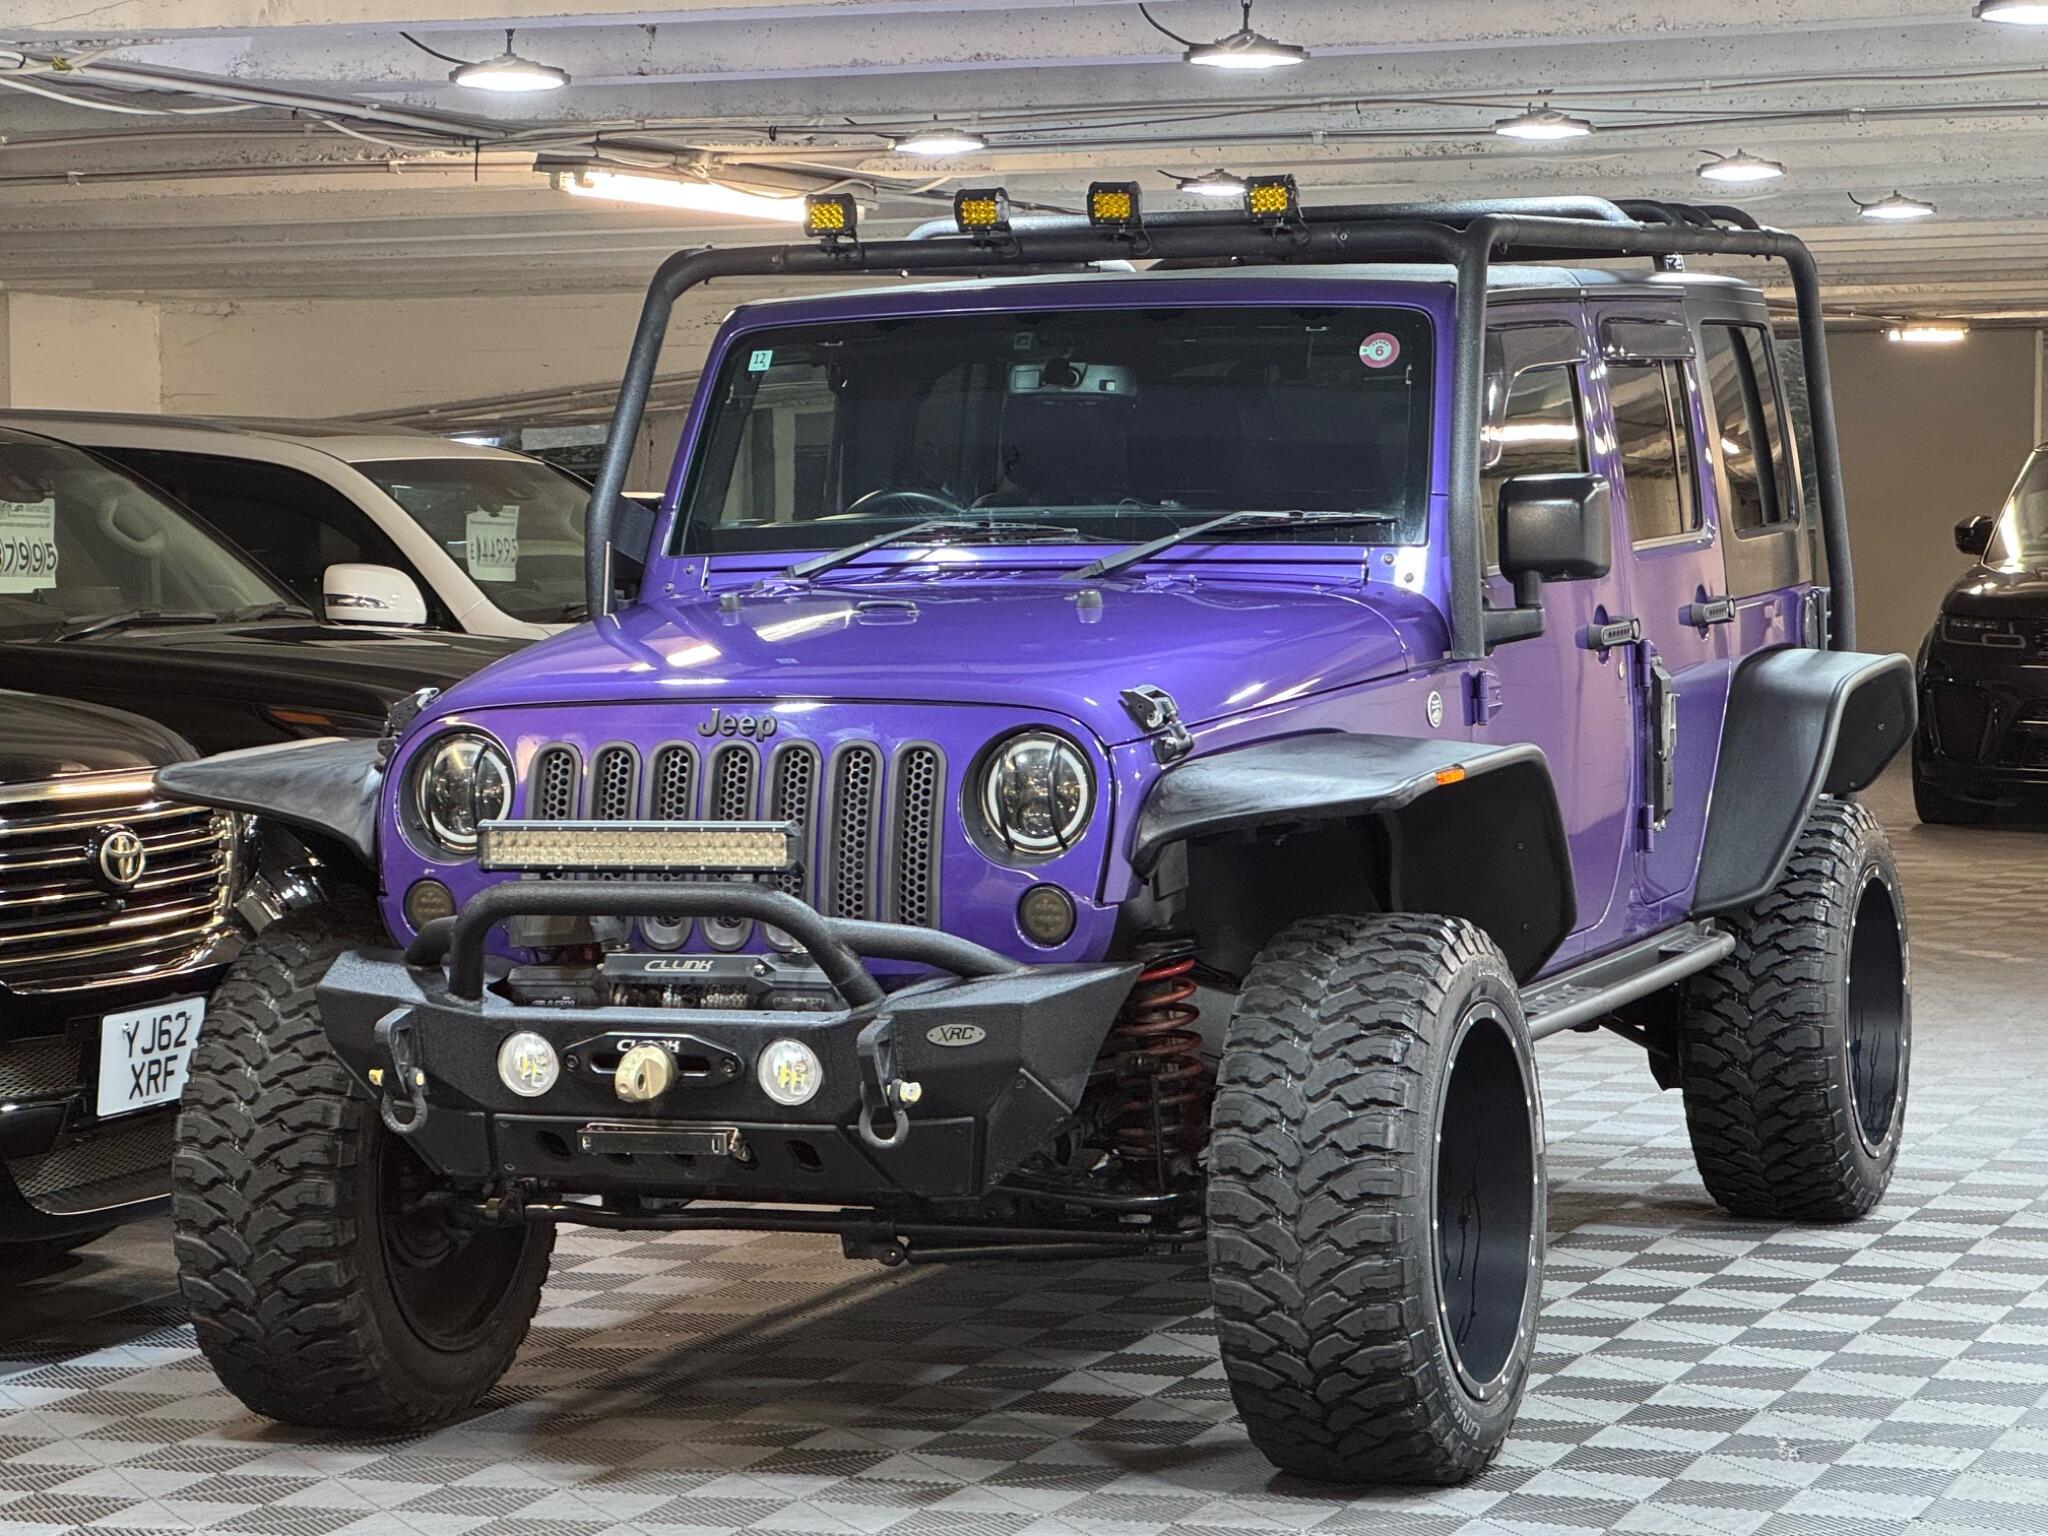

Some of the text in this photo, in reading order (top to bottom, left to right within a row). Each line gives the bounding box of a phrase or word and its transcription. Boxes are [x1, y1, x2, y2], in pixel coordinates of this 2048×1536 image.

[754, 352, 766, 364] 12
[1375, 346, 1384, 356] 6
[0, 542, 57, 572] 7995
[697, 707, 777, 742] Jeep
[125, 1011, 188, 1058] YJ62
[937, 1026, 975, 1042] XRC
[129, 1055, 178, 1100] XRF
